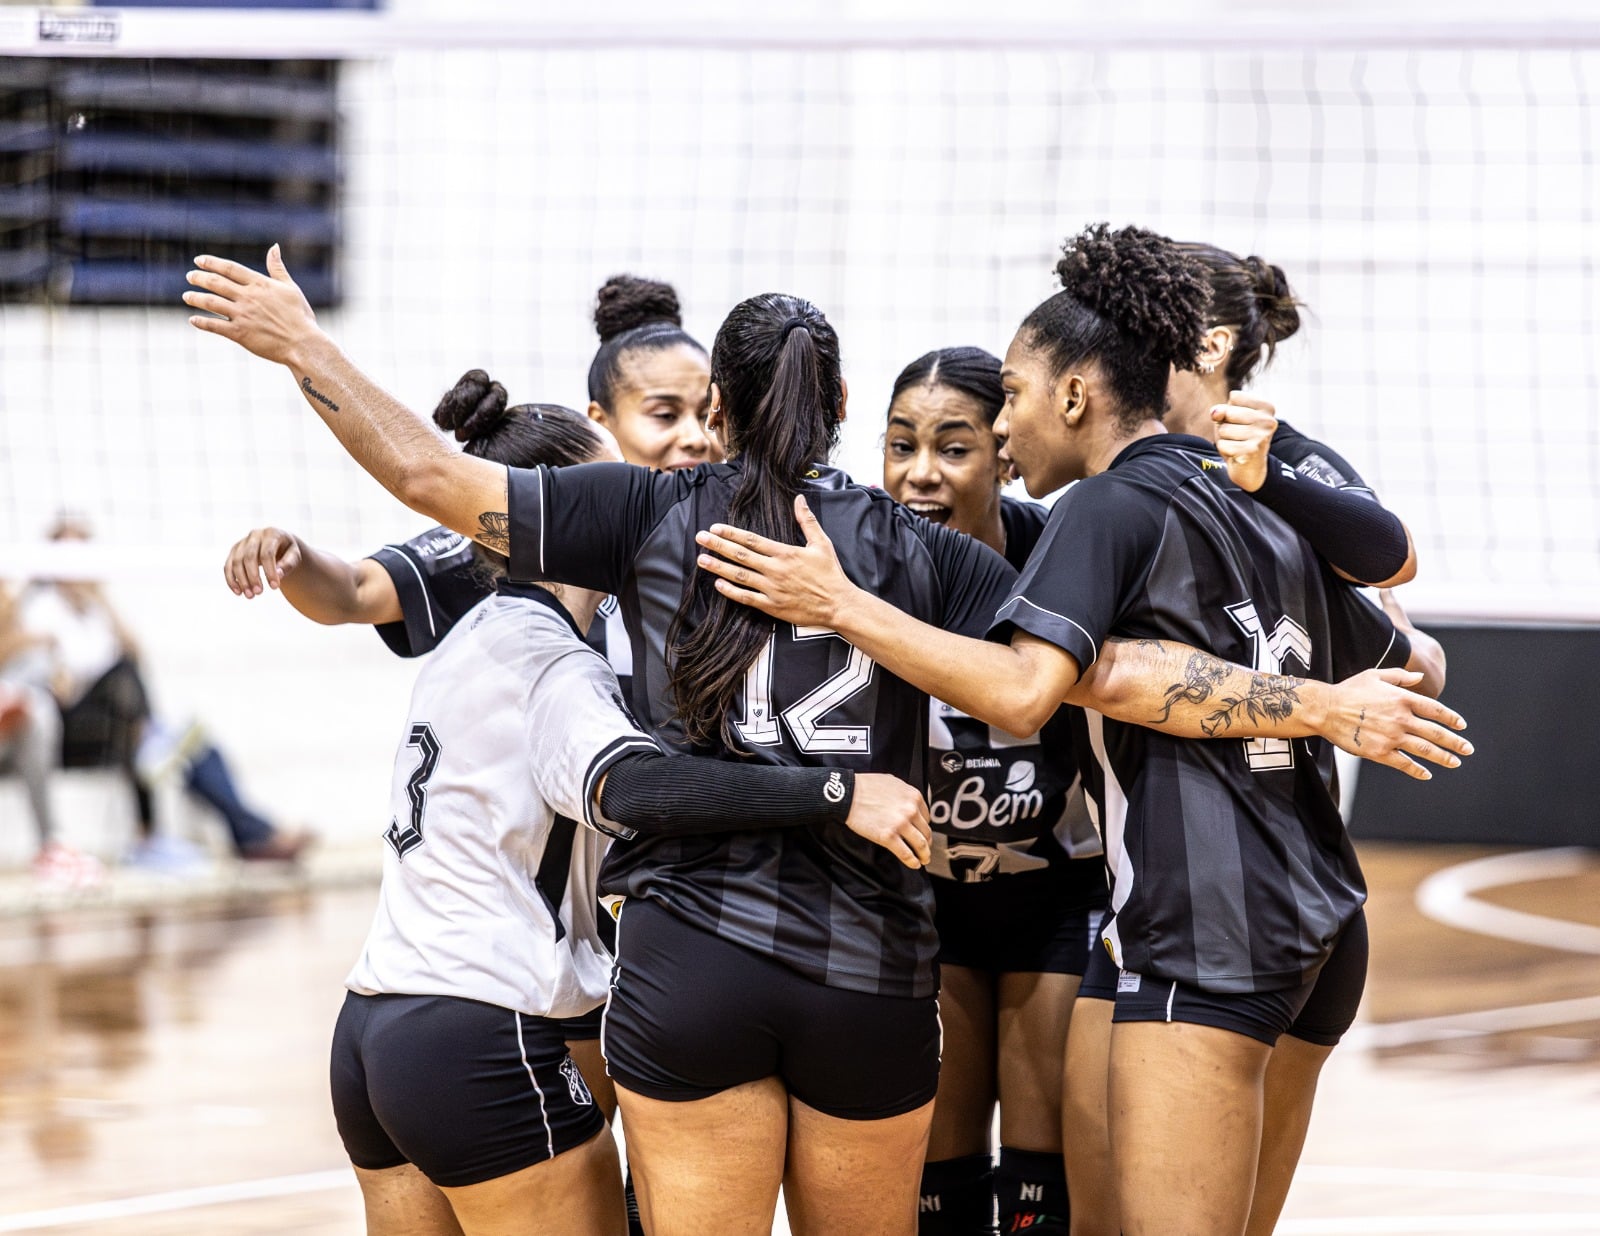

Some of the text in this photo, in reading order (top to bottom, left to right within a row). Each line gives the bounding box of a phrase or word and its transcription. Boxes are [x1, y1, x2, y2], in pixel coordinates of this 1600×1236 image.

[734, 623, 876, 754] 12
[382, 722, 443, 863] 3
[929, 776, 1043, 829] oBem
[946, 843, 1000, 883] 7
[920, 1194, 942, 1213] N1
[1019, 1182, 1044, 1202] N1
